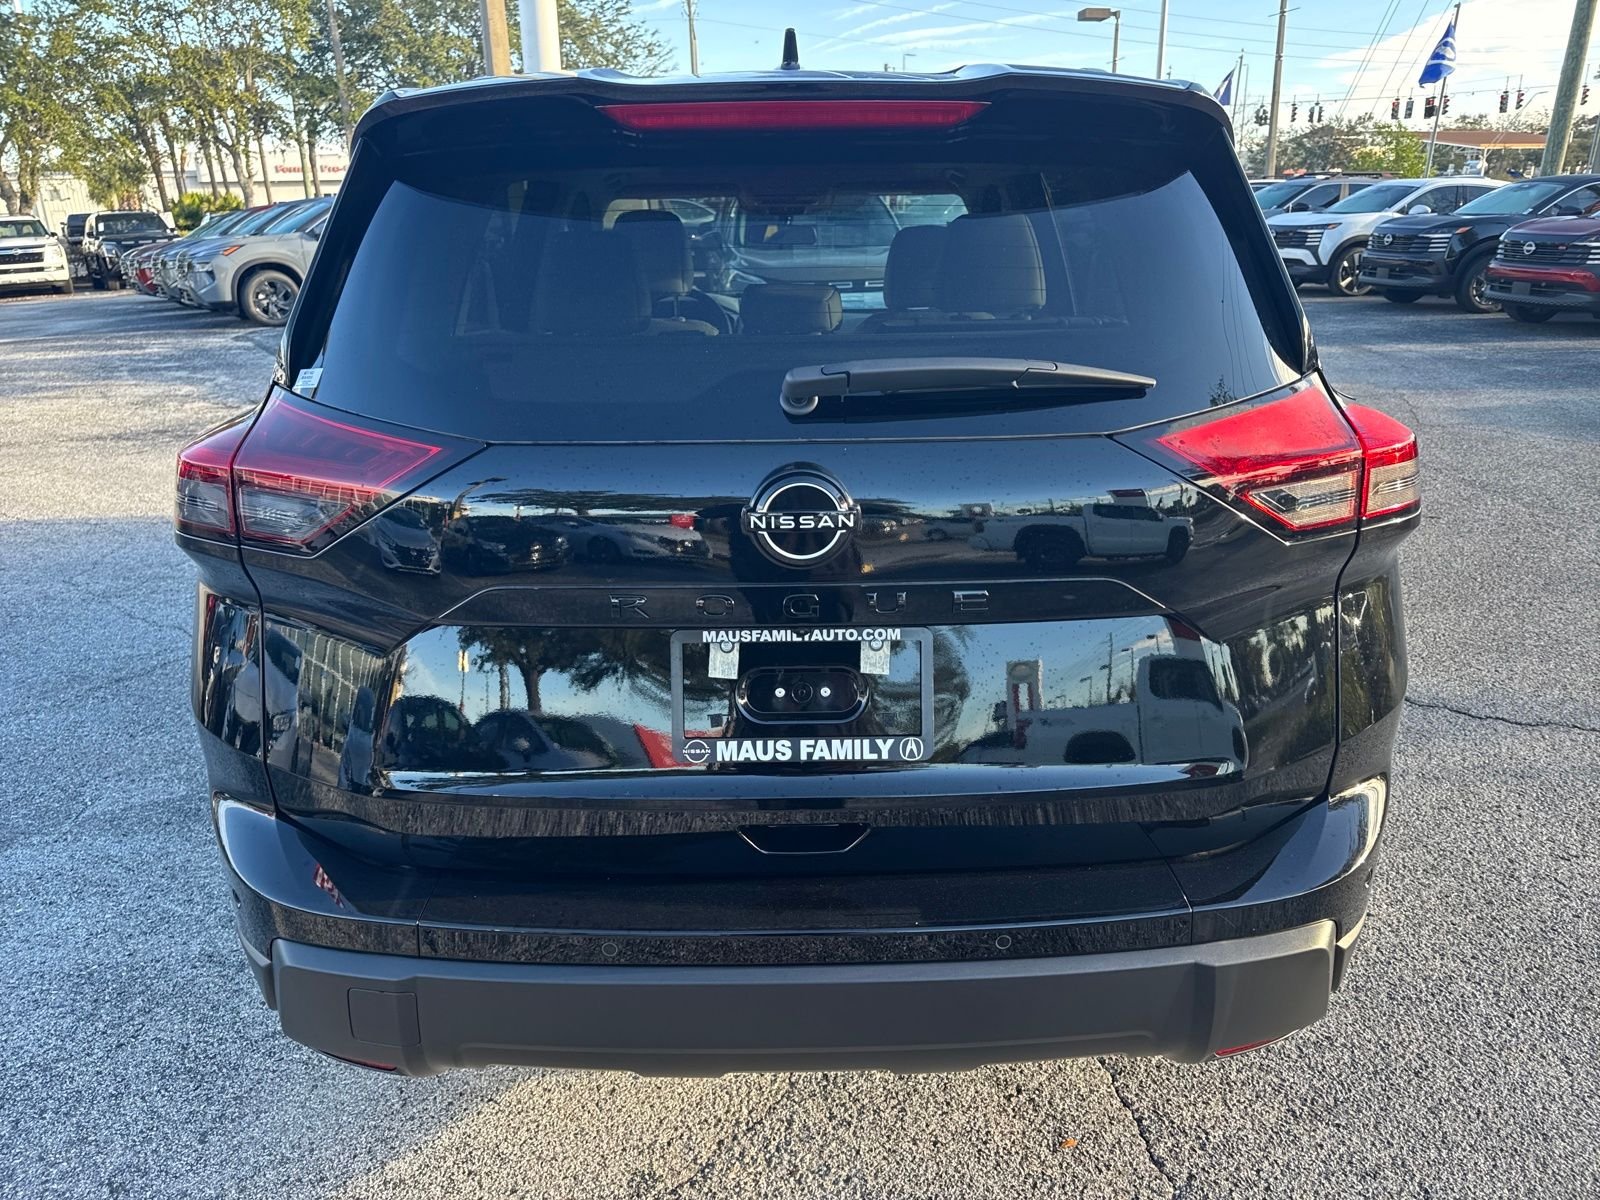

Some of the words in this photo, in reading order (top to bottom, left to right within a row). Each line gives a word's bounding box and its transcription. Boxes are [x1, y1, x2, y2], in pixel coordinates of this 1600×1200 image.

[750, 514, 854, 529] NISSAN
[609, 590, 990, 619] ROGUE
[716, 740, 793, 761] MAUS
[799, 738, 895, 760] FAMILY
